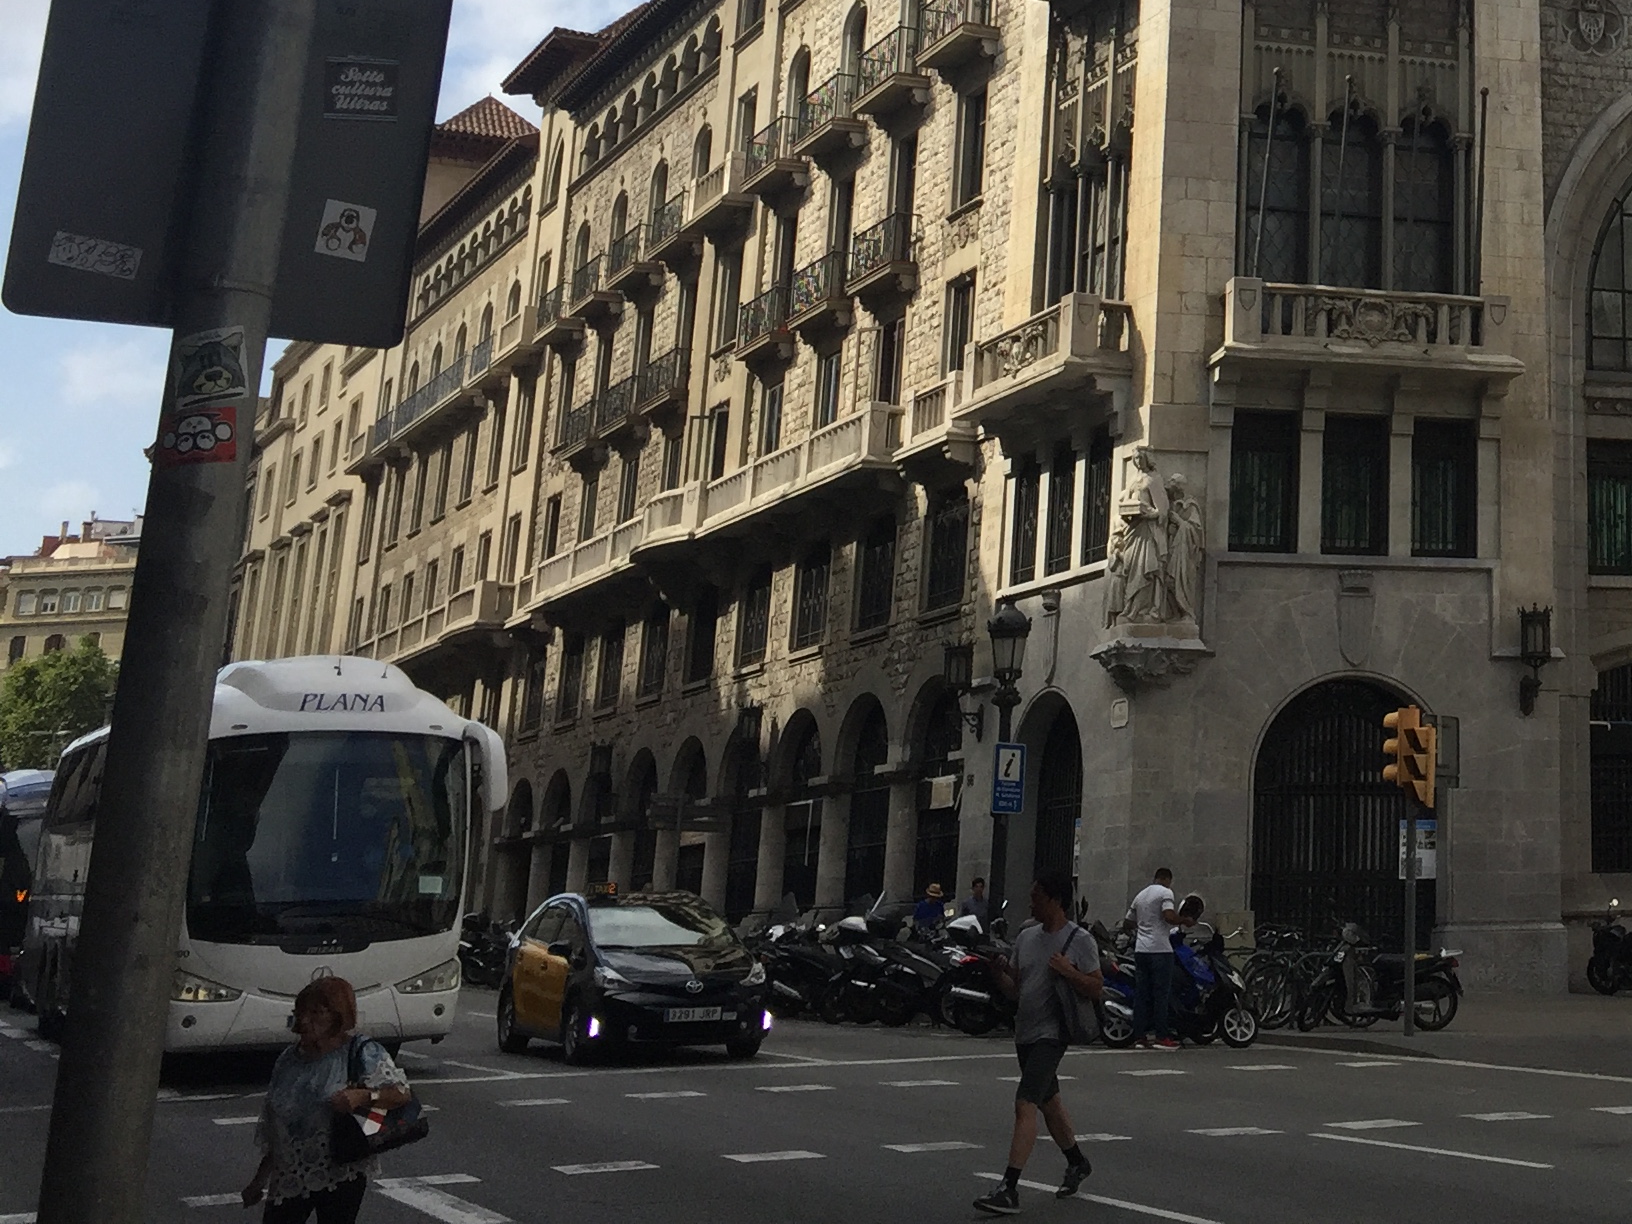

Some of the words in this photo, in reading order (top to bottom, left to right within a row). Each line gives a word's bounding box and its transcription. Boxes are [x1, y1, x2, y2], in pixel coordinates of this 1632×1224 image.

[331, 82, 392, 96] cultura
[335, 95, 388, 110] Ultras
[299, 693, 385, 712] PLANA
